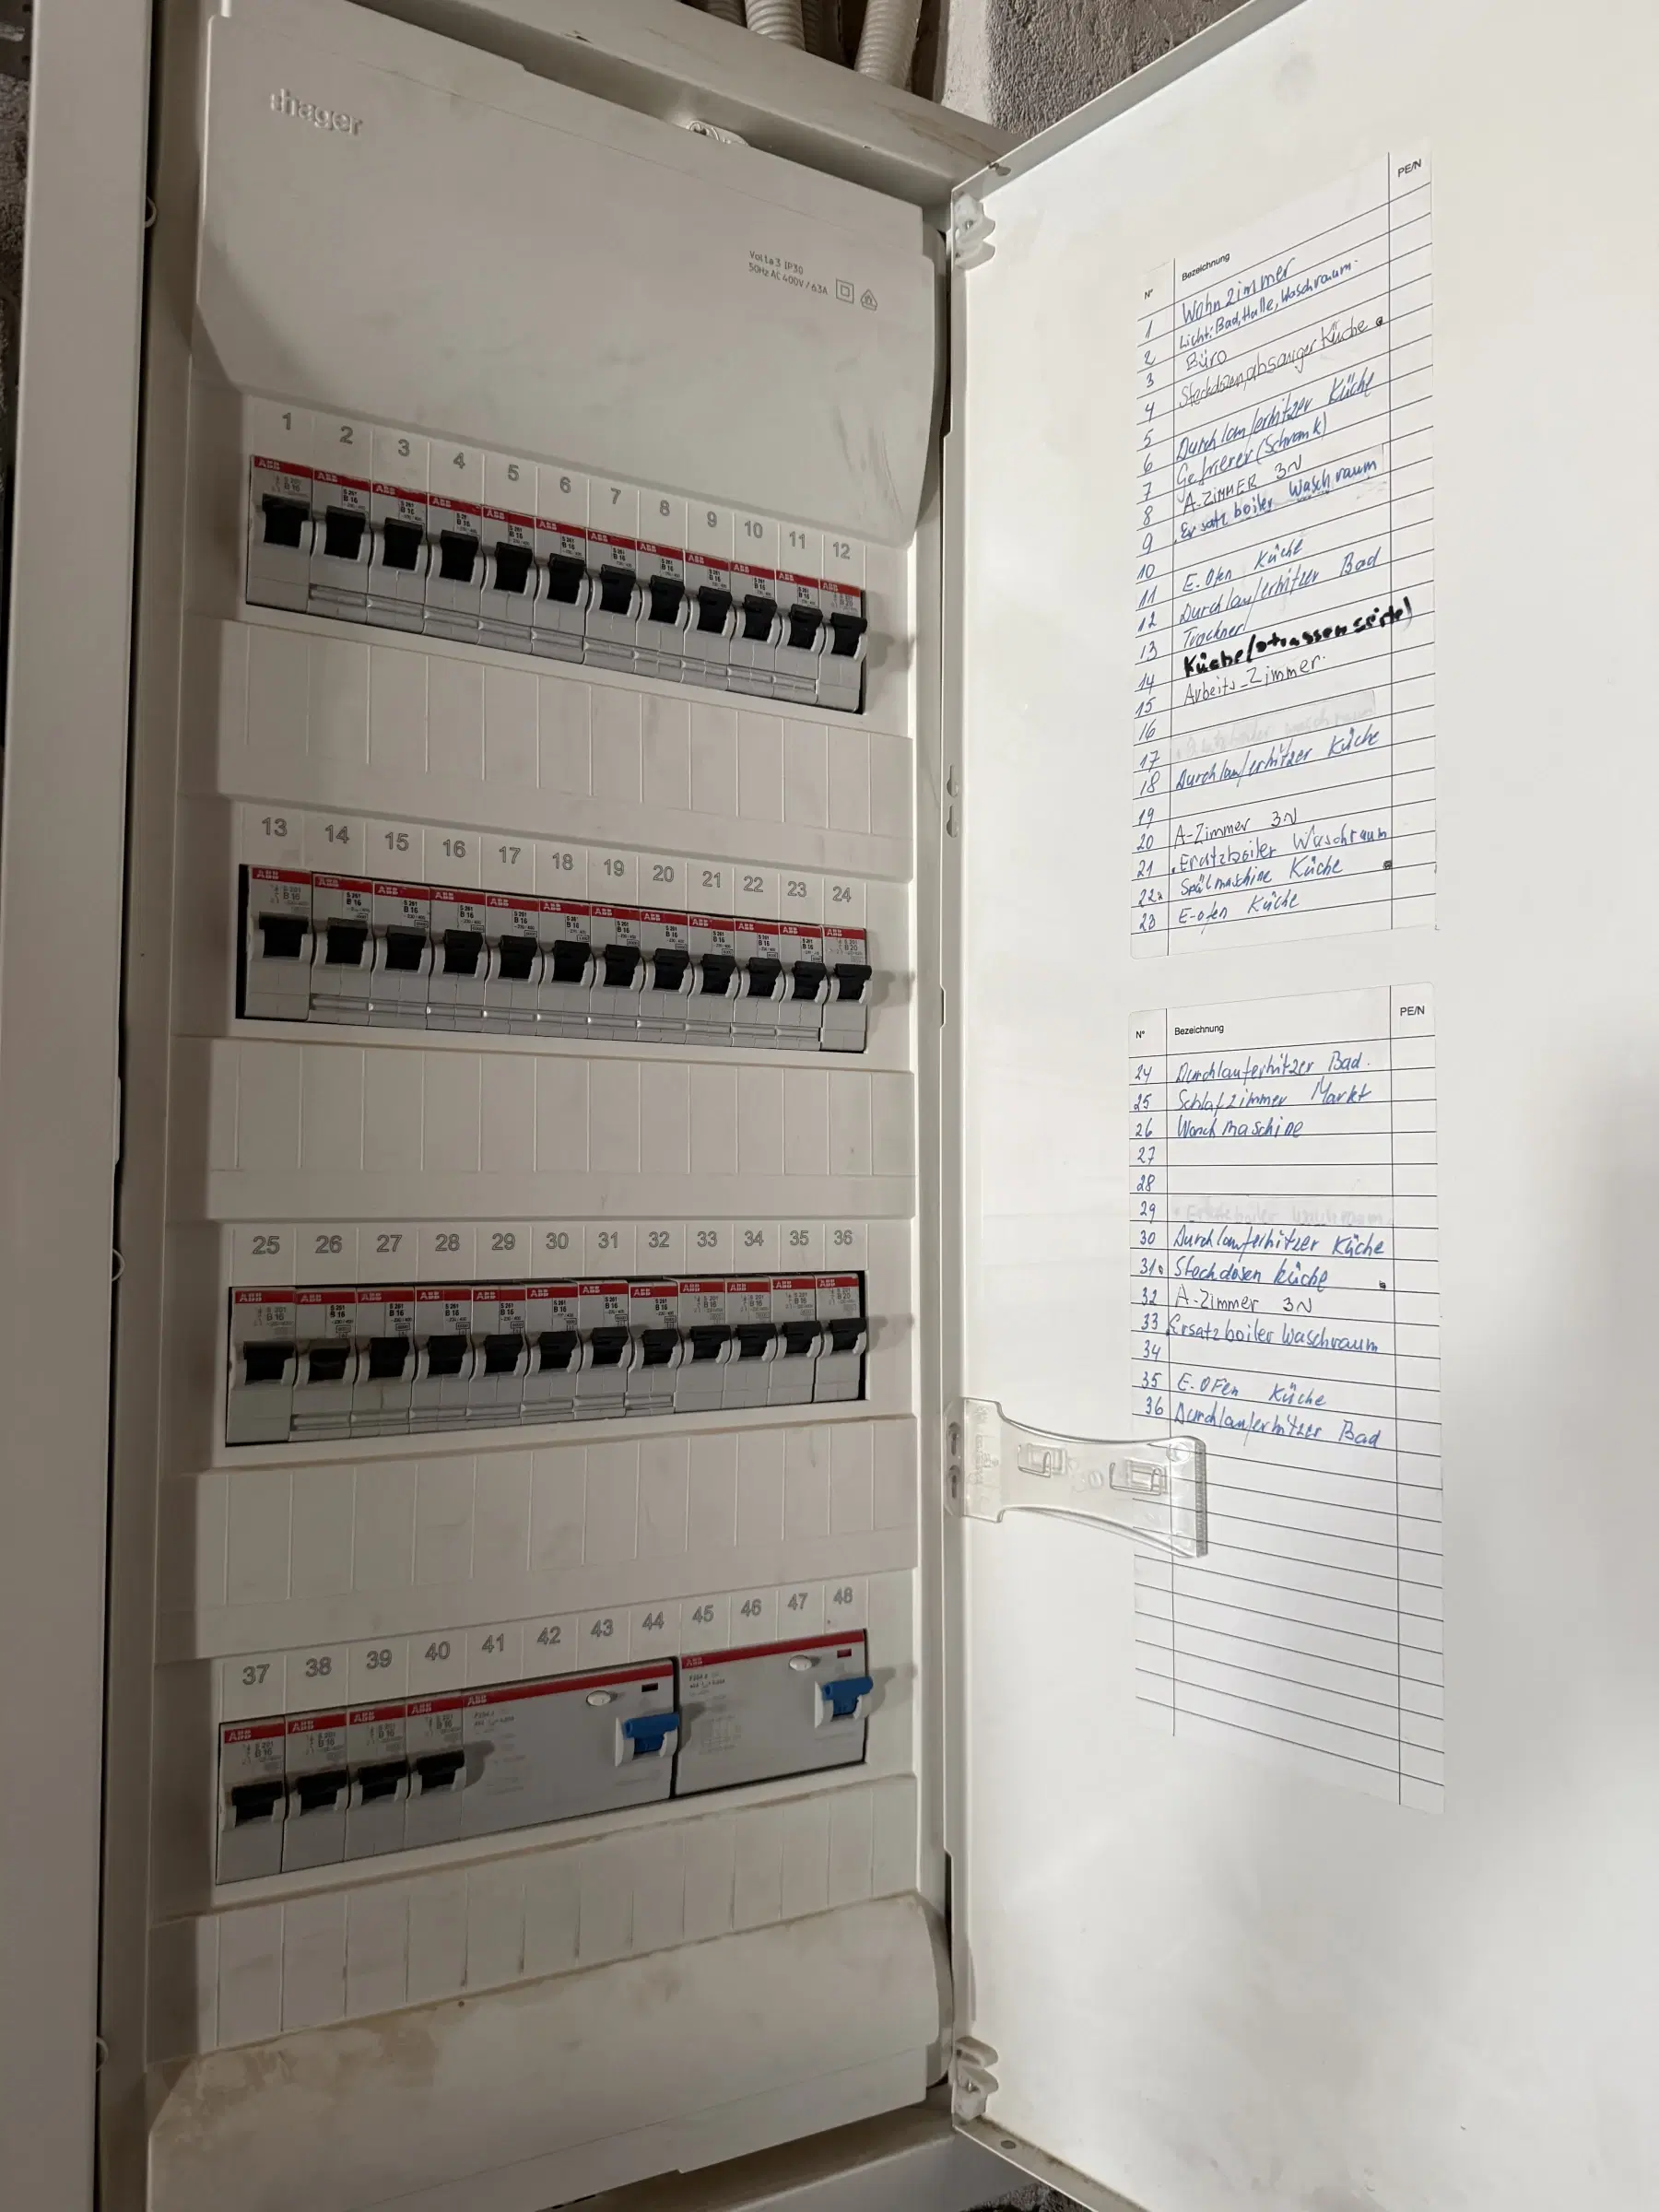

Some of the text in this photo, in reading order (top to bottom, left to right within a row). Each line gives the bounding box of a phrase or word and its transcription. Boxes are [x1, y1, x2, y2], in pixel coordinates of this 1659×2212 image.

[280, 88, 363, 136] hager
[1182, 253, 1230, 281] Bezeichnung
[1397, 159, 1422, 177] PE/N
[785, 261, 804, 275] IP30
[748, 262, 828, 295] 50Hz AC 400V 63A
[1145, 319, 1153, 339] 1
[1144, 353, 1156, 365] 2
[1147, 349, 1227, 388] 3 Büro
[282, 412, 291, 430] 1
[1145, 402, 1154, 422] 4
[339, 426, 353, 445] 2
[1144, 429, 1154, 447] 5
[398, 439, 410, 457] 3
[258, 459, 280, 471] ABB
[453, 452, 465, 469] 4
[1144, 453, 1152, 473] 6
[507, 465, 520, 481] 5
[376, 484, 395, 495] ABB
[559, 477, 571, 494] 6
[1143, 484, 1151, 501] 7
[610, 488, 621, 504] 7
[659, 500, 670, 516] 8
[1144, 506, 1153, 525] 8
[706, 511, 718, 528] 9
[745, 521, 763, 539] 10
[789, 531, 806, 549] 11
[1143, 535, 1153, 554] 9
[833, 541, 851, 560] 12
[1136, 564, 1155, 580] 10
[823, 582, 838, 592] ABB
[1138, 613, 1157, 631] 12
[1340, 546, 1382, 577] Bad
[1138, 587, 1158, 607] 11
[1139, 641, 1158, 660] 13
[1137, 673, 1155, 693] 14
[1135, 697, 1157, 715] 15
[1138, 719, 1157, 741] 16
[1139, 750, 1160, 772] 17
[1140, 771, 1160, 795] 18
[262, 817, 288, 837] 13
[1138, 807, 1154, 829] 19
[325, 824, 349, 844] 14
[385, 832, 409, 852] 15
[1136, 833, 1154, 851] 20
[443, 840, 466, 857] 16
[499, 846, 521, 864] 17
[552, 853, 573, 870] 18
[604, 859, 625, 877] 19
[1137, 860, 1154, 877] 21
[653, 865, 675, 883] 20
[702, 870, 722, 888] 21
[378, 886, 399, 896] ABB
[744, 876, 763, 893] 22
[787, 881, 807, 898] 23
[833, 886, 852, 902] 24
[1139, 889, 1157, 908] 22
[692, 918, 709, 926] ABB
[1138, 912, 1157, 932] 23
[828, 928, 842, 936] ABB
[1174, 1023, 1224, 1036] Bezeichnung
[1400, 1006, 1425, 1016] PE/N
[1135, 1065, 1152, 1084] 24
[1134, 1093, 1151, 1112] 25
[1135, 1118, 1153, 1137] 26
[1136, 1146, 1156, 1167] 27
[1136, 1174, 1155, 1192] 28
[1139, 1201, 1157, 1224] 29
[253, 1235, 280, 1254] 25
[315, 1234, 343, 1253] 26
[377, 1234, 402, 1253] 27
[435, 1233, 460, 1252] 28
[492, 1233, 515, 1251] 29
[546, 1231, 570, 1249] 30
[598, 1231, 618, 1249] 31
[649, 1231, 670, 1248] 32
[697, 1230, 718, 1247] 33
[744, 1230, 764, 1247] 34
[790, 1230, 809, 1246] 35
[833, 1230, 853, 1246] 36
[1139, 1230, 1157, 1245] 30
[1331, 1231, 1384, 1257] Küche
[1140, 1259, 1154, 1275] 31
[420, 1291, 441, 1300] ABB
[683, 1284, 700, 1292] ABB
[1141, 1288, 1158, 1306] 32
[1141, 1313, 1159, 1331] 33
[1143, 1340, 1160, 1359] 34
[1142, 1371, 1327, 1406] 35 Küche
[1145, 1396, 1163, 1416] 36
[1339, 1419, 1382, 1449] Bad
[787, 1593, 808, 1610] 47
[833, 1586, 853, 1605] 48
[692, 1605, 714, 1624] 45
[741, 1598, 762, 1618] 46
[591, 1618, 614, 1638] 43
[642, 1611, 665, 1630] 44
[482, 1633, 504, 1653] 41
[538, 1626, 561, 1645] 42
[367, 1649, 393, 1669] 39
[425, 1641, 451, 1661] 40
[242, 1664, 270, 1685] 37
[306, 1656, 332, 1677] 38
[467, 1695, 488, 1705] ABB
[229, 1730, 252, 1741] ABB
